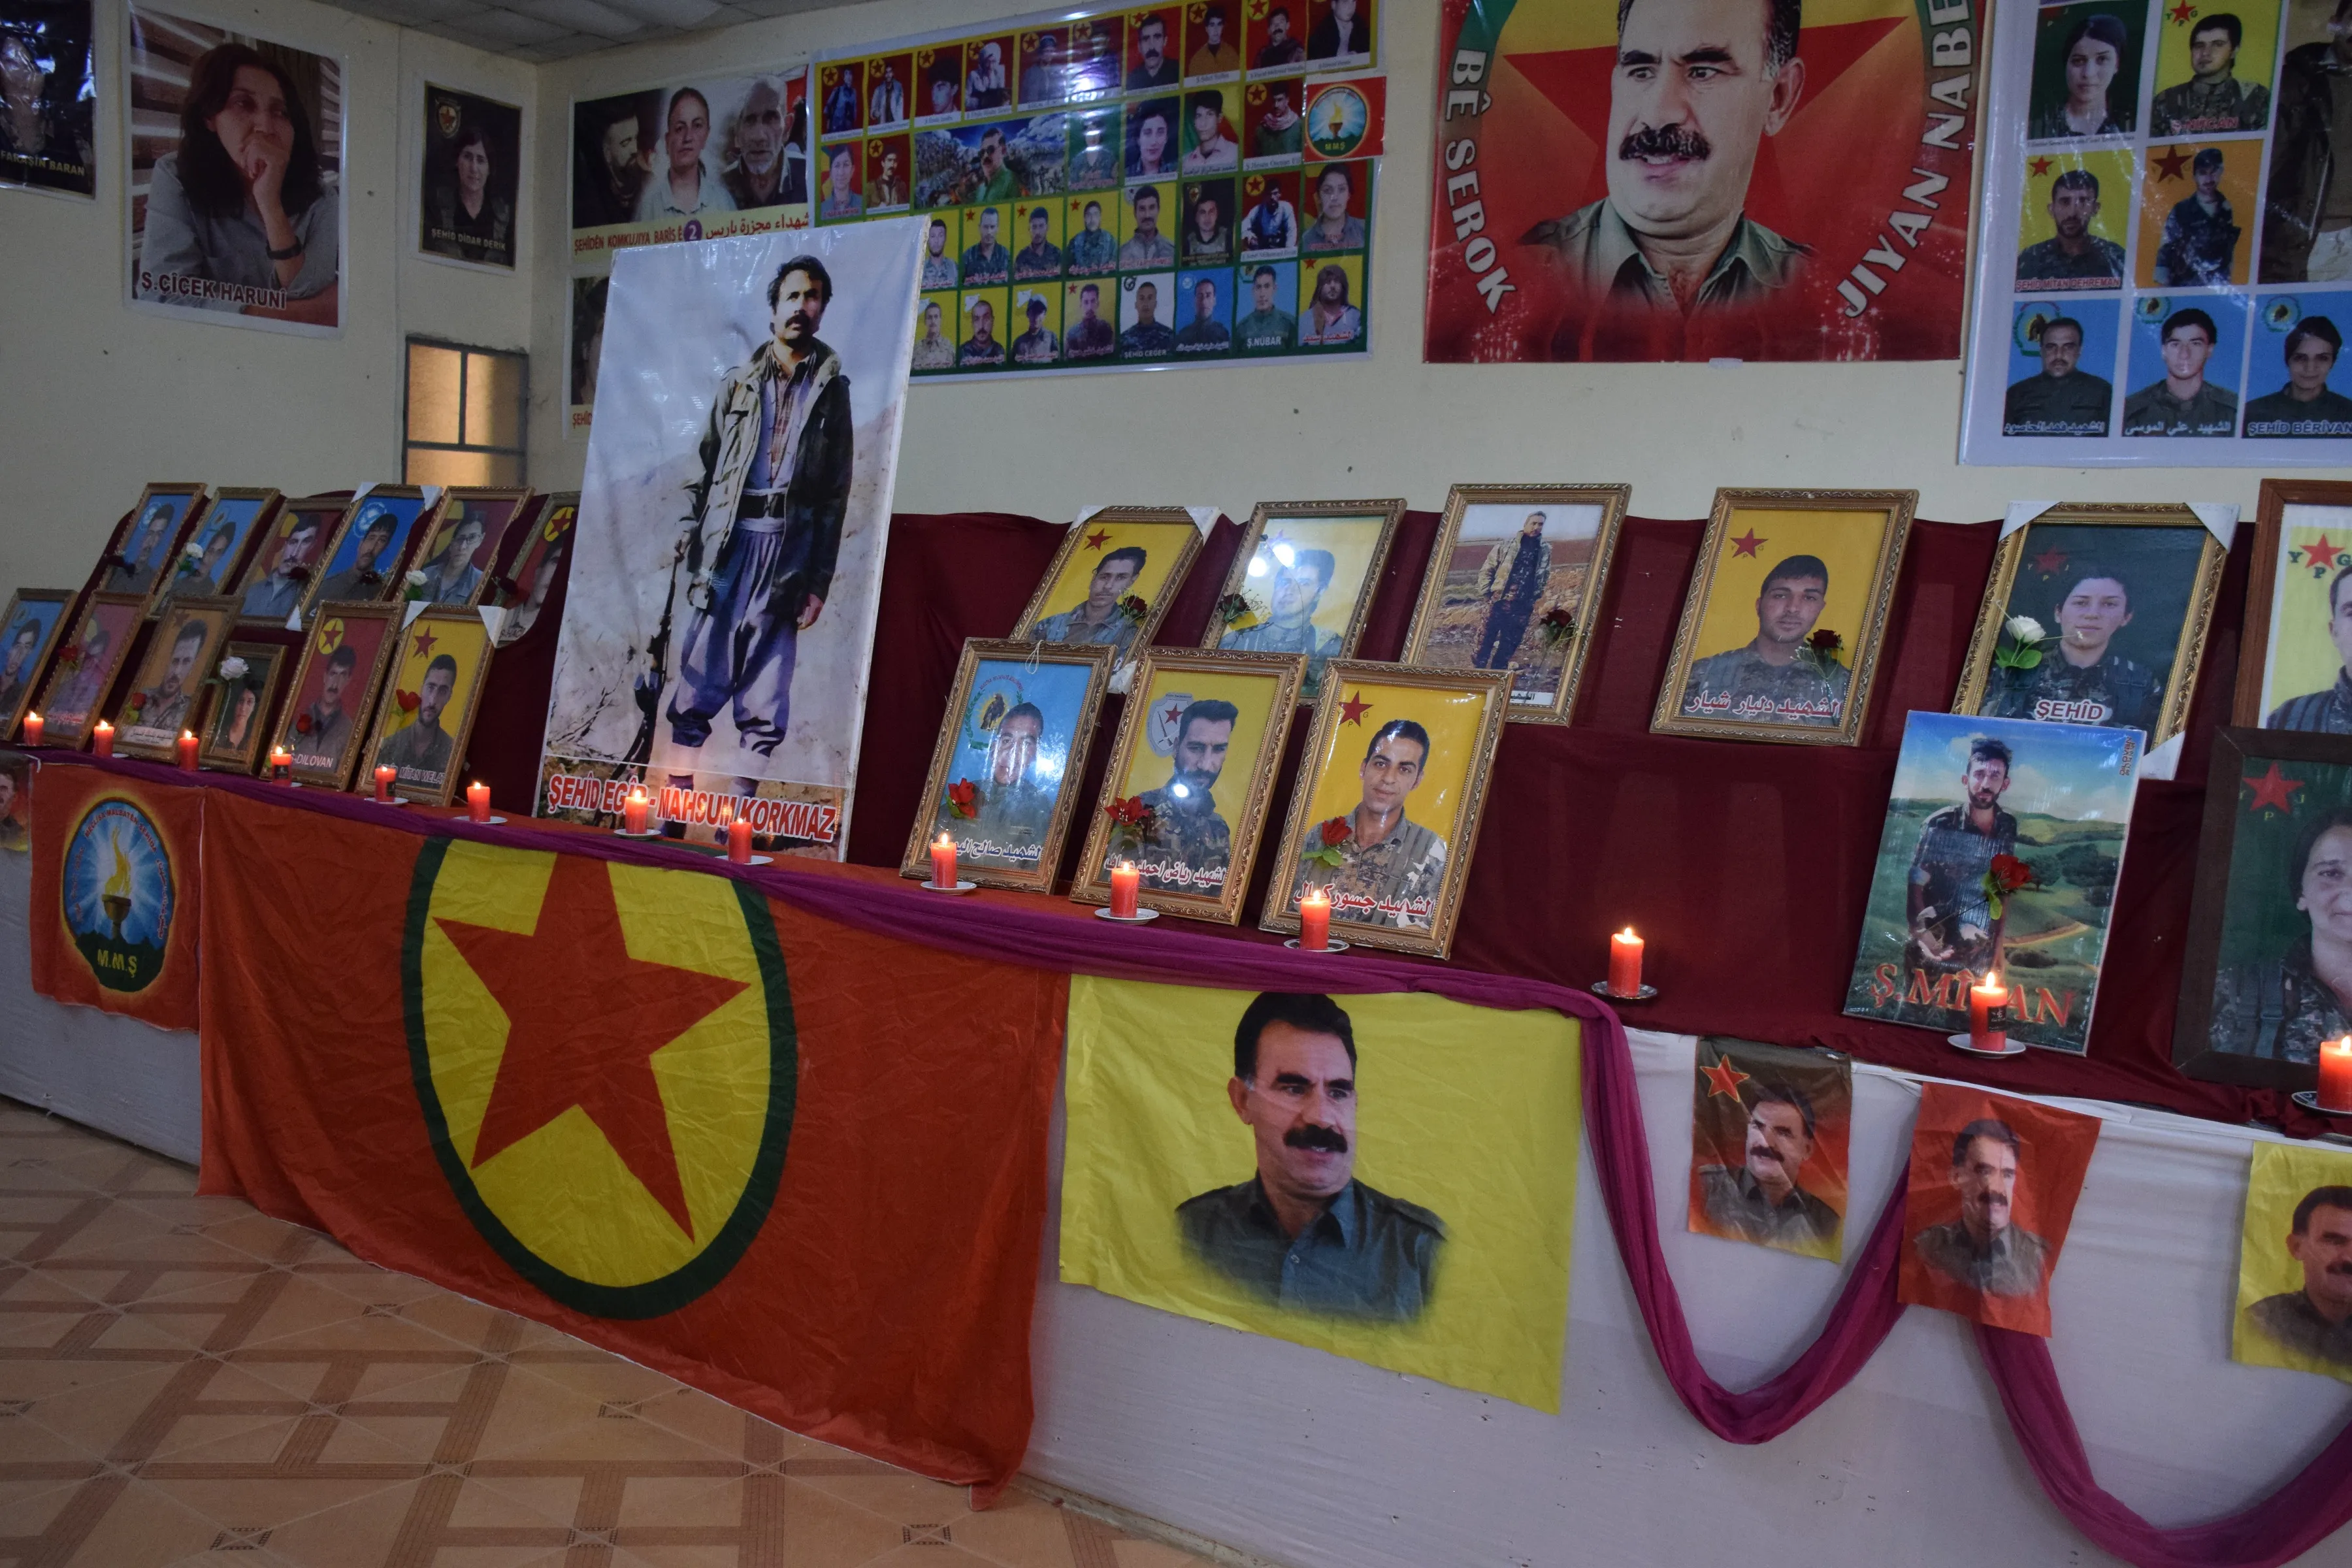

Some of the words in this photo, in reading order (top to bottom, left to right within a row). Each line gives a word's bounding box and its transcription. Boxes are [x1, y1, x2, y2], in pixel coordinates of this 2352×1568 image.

[1445, 49, 1491, 121] BÊ
[49, 160, 85, 176] BARAN
[689, 225, 697, 240] 2
[1445, 139, 1517, 316] SEROK
[1834, 167, 1951, 319] JIYAN
[2313, 566, 2326, 579] P
[1686, 690, 1732, 713] شيار
[1733, 694, 1775, 717] دليار
[2036, 699, 2105, 721] ŞEHÎD
[548, 772, 602, 815] ŞEHÎD
[657, 786, 738, 829] MAHSUM
[734, 796, 838, 843] KORKMAZ
[1002, 844, 1042, 863] لشهيد
[1193, 866, 1228, 888] لشهيد
[1870, 963, 2075, 1028] Ş.MÎAN
